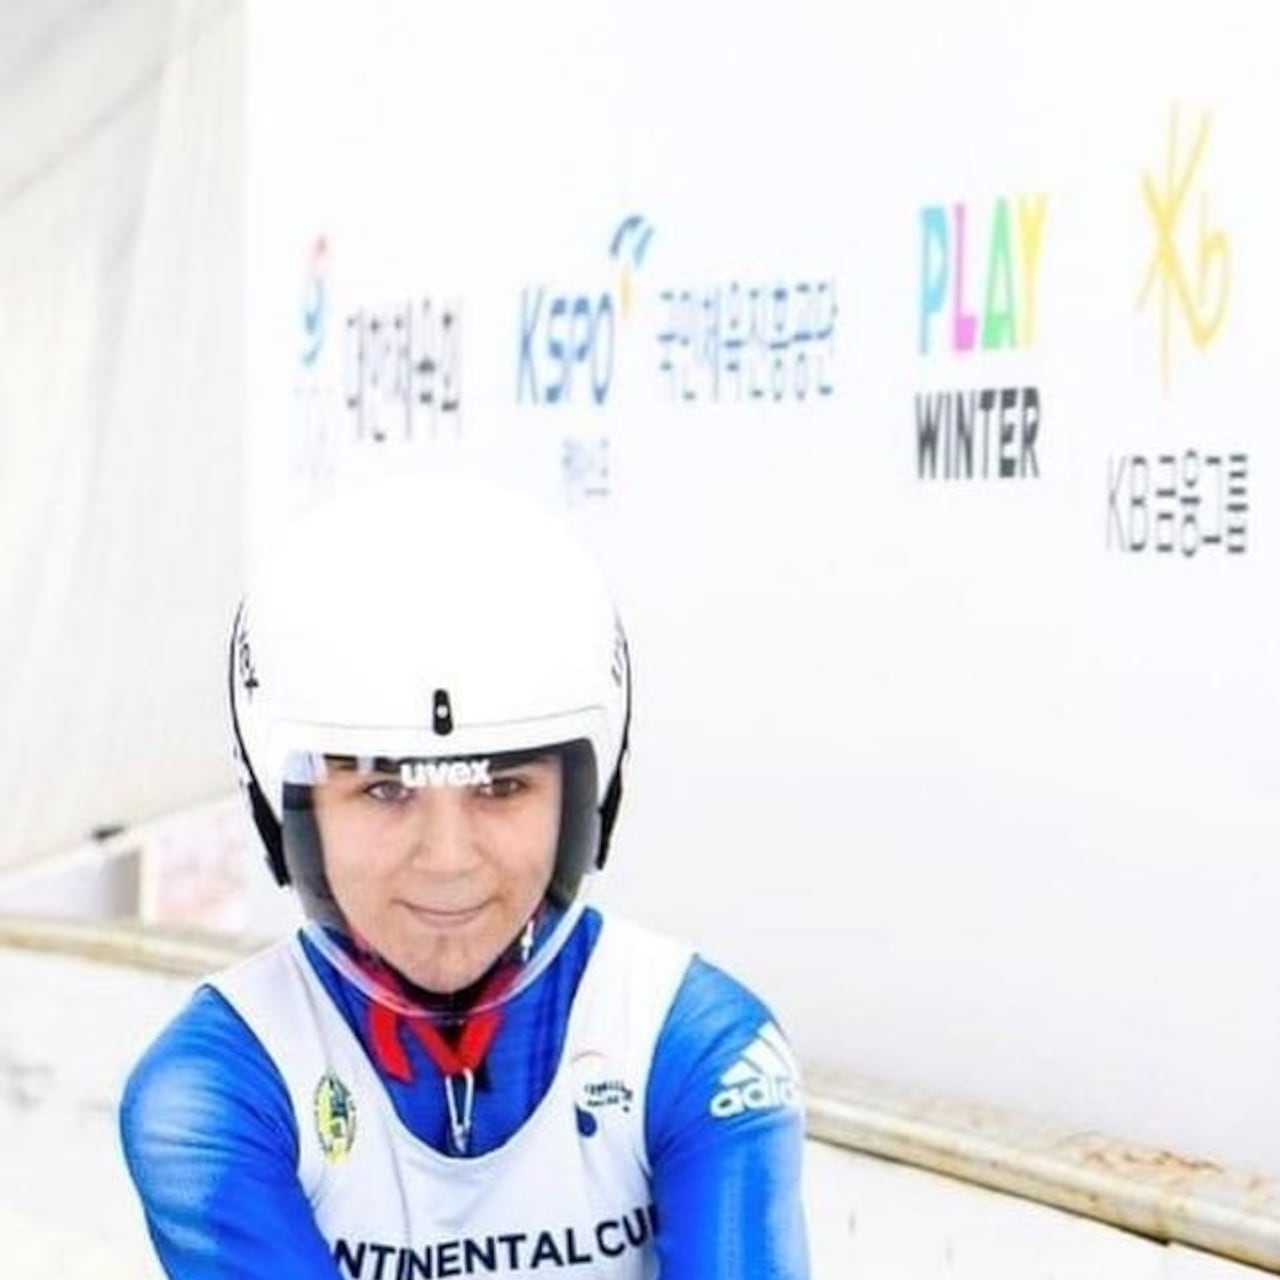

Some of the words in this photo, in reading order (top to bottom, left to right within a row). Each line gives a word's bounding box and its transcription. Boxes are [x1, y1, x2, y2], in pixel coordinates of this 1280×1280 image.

[917, 191, 1048, 356] PLAY
[516, 285, 614, 405] KSPO
[913, 386, 1041, 480] WINTER
[1106, 448, 1249, 558] KB금융그룹
[400, 758, 493, 788] uvex
